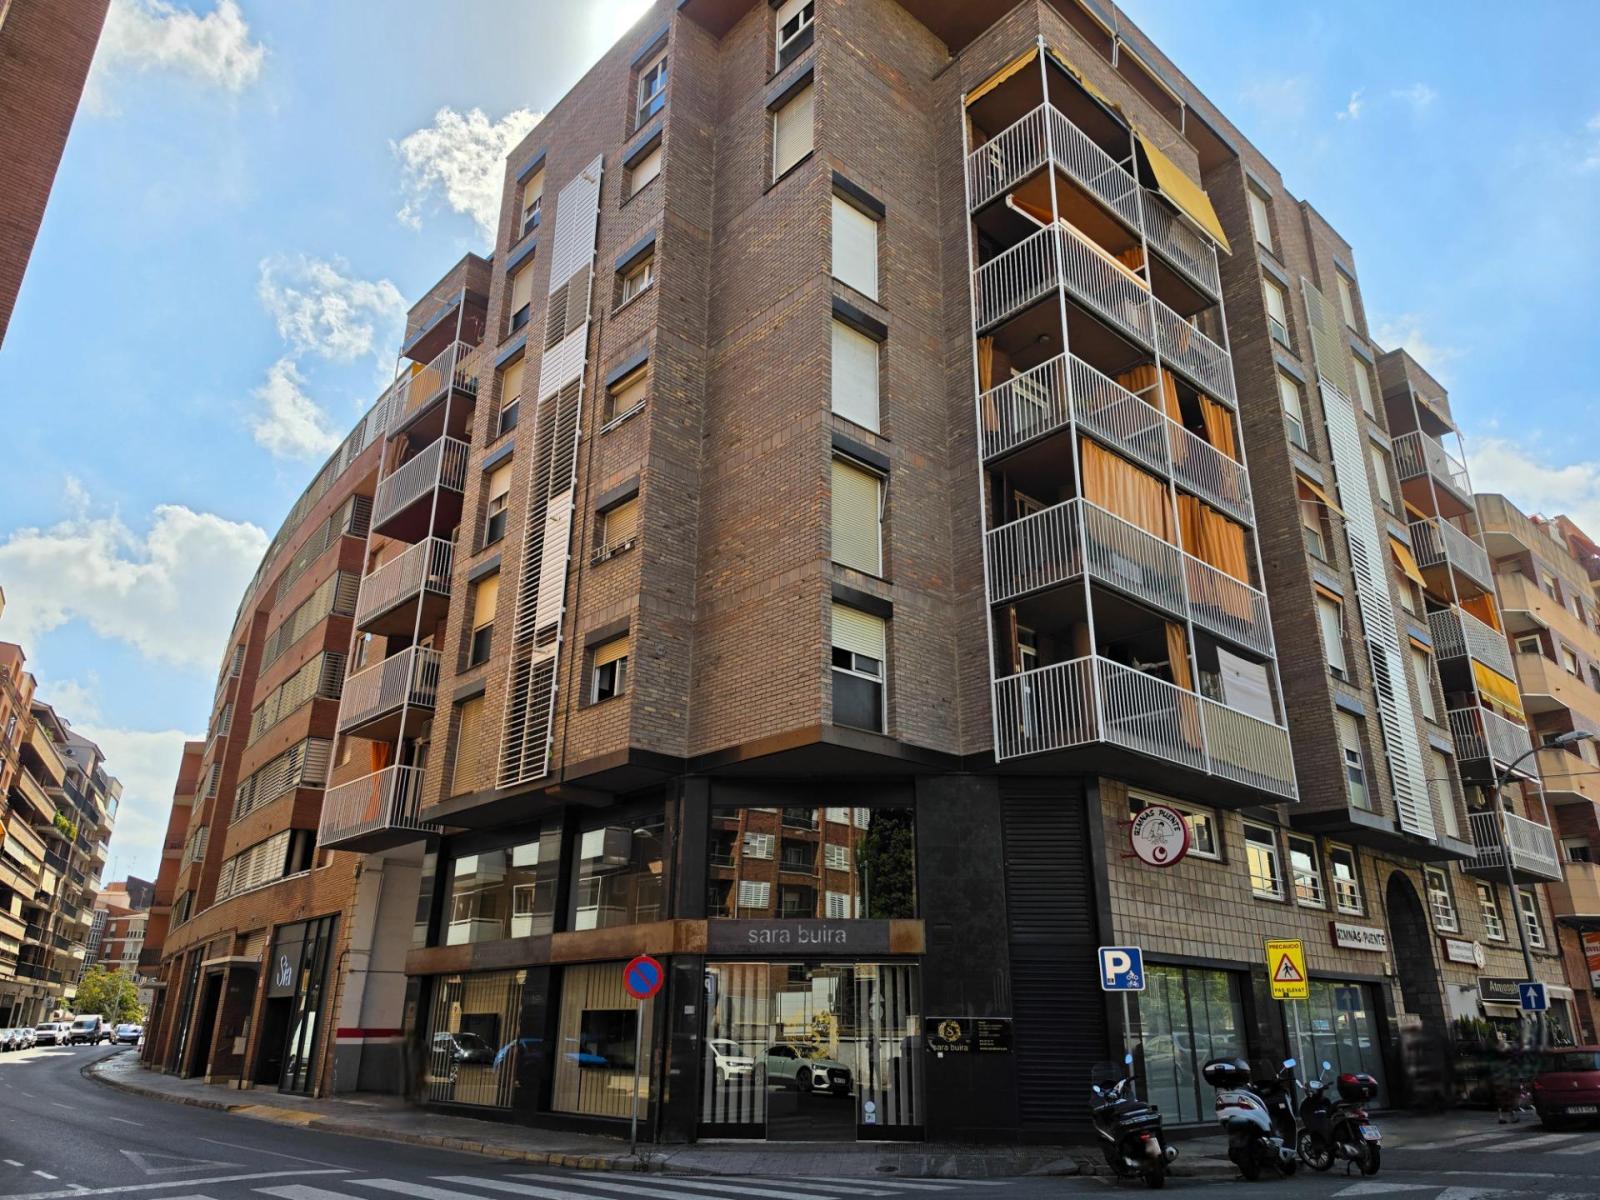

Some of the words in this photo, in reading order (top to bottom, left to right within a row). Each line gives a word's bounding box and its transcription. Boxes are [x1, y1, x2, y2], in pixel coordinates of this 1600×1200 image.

[748, 929, 790, 943] sara
[798, 924, 847, 943] buira
[1103, 950, 1131, 986] P
